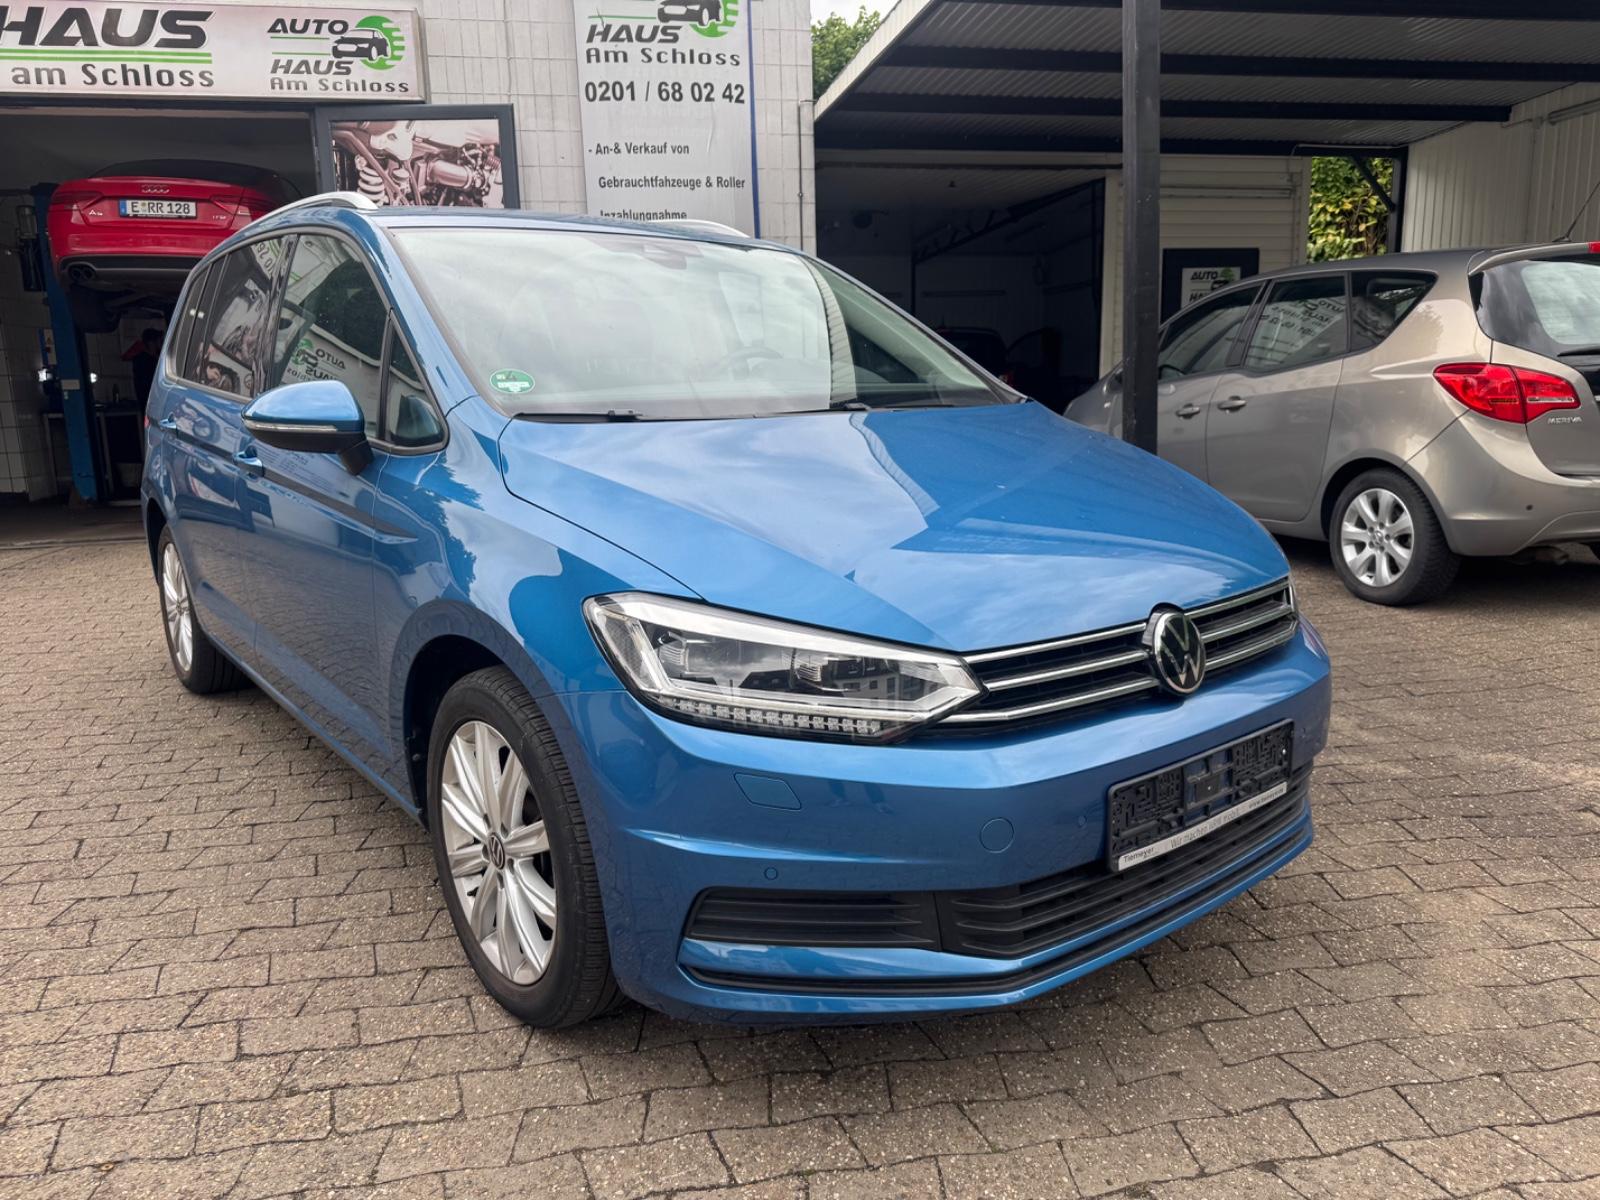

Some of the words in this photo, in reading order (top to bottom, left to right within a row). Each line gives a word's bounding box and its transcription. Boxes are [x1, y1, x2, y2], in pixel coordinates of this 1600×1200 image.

[0, 6, 214, 49] HAUS
[267, 18, 349, 35] AUTO
[586, 24, 682, 44] HAUS
[586, 48, 628, 64] Am
[641, 48, 741, 66] Schloss
[11, 66, 66, 85] am
[82, 64, 214, 87] Schloss
[270, 59, 354, 76] HAUS
[270, 77, 308, 91] Am
[318, 79, 409, 93] Schloss
[585, 81, 636, 102] 0201
[657, 82, 683, 102] 68
[690, 82, 715, 102] 02
[722, 83, 745, 104] 42
[625, 142, 667, 155] Verkauf
[671, 145, 690, 154] von
[705, 177, 713, 187] &
[716, 177, 745, 189] Roller
[131, 202, 140, 213] E
[147, 203, 164, 214] RR
[167, 203, 190, 214] 128
[1191, 271, 1218, 280] AUTO
